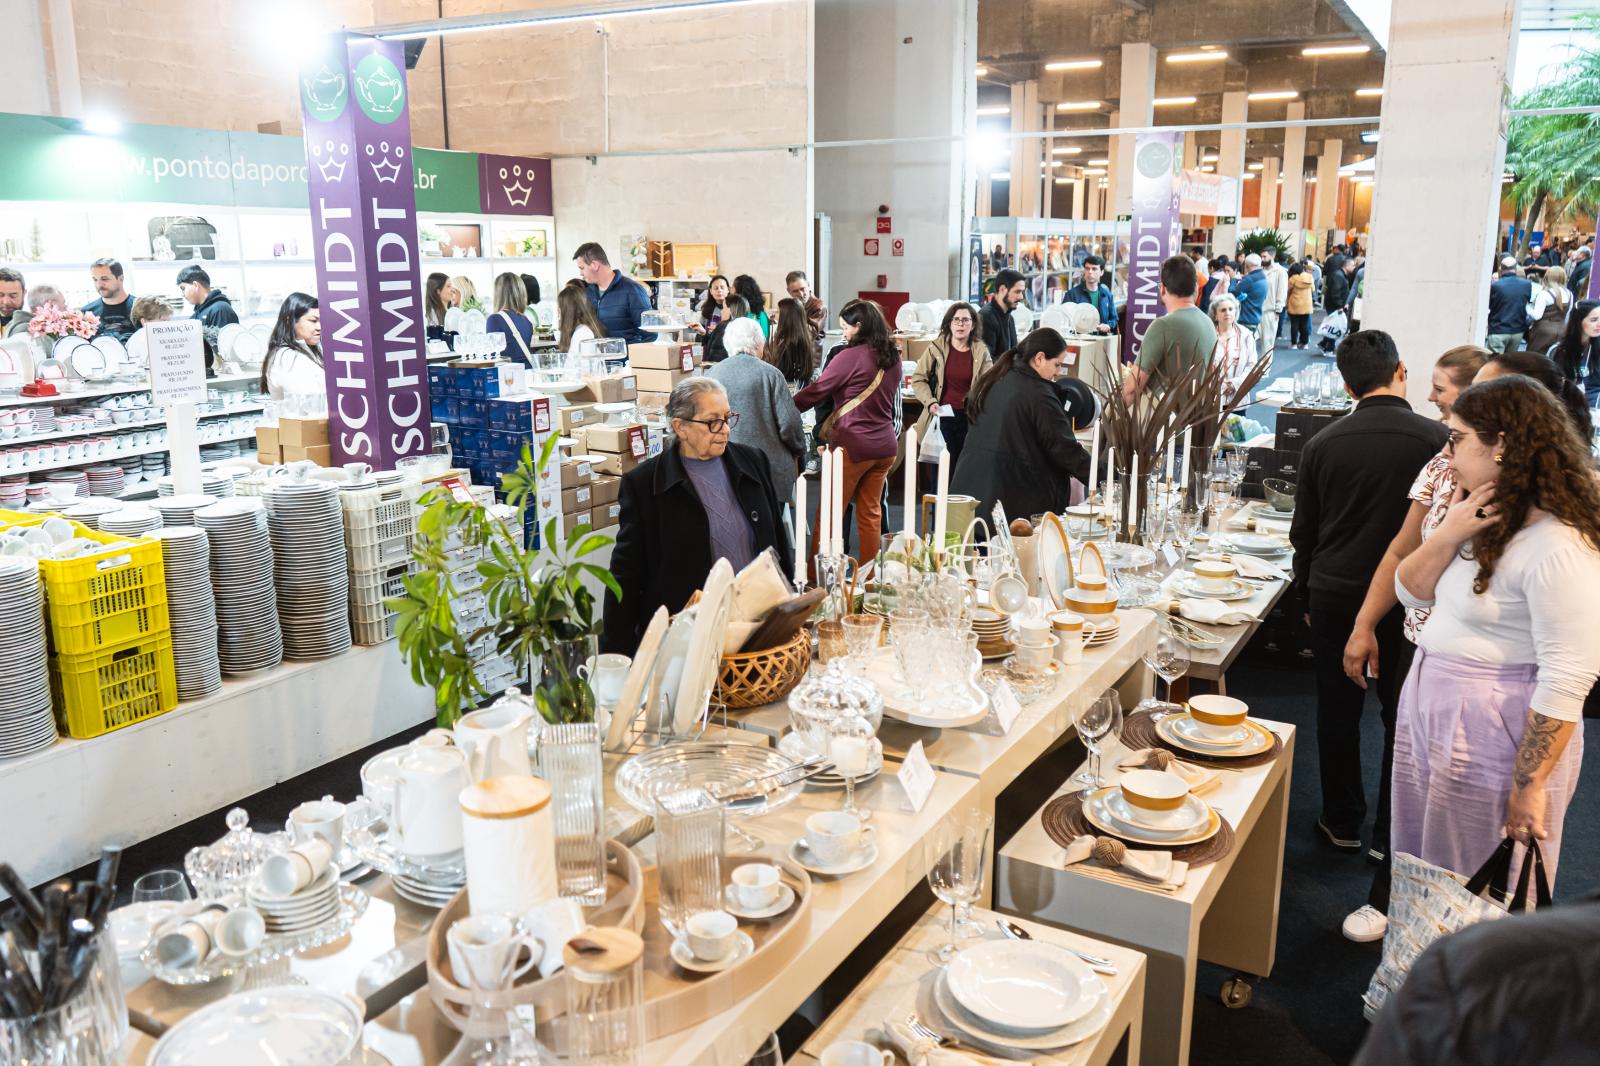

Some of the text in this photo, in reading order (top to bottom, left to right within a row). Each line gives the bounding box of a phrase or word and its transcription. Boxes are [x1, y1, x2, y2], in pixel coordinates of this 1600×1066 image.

[152, 324, 194, 334] PROMOÇÃO
[320, 197, 372, 458] SCHMIDT
[372, 197, 425, 456] SCHMIDT
